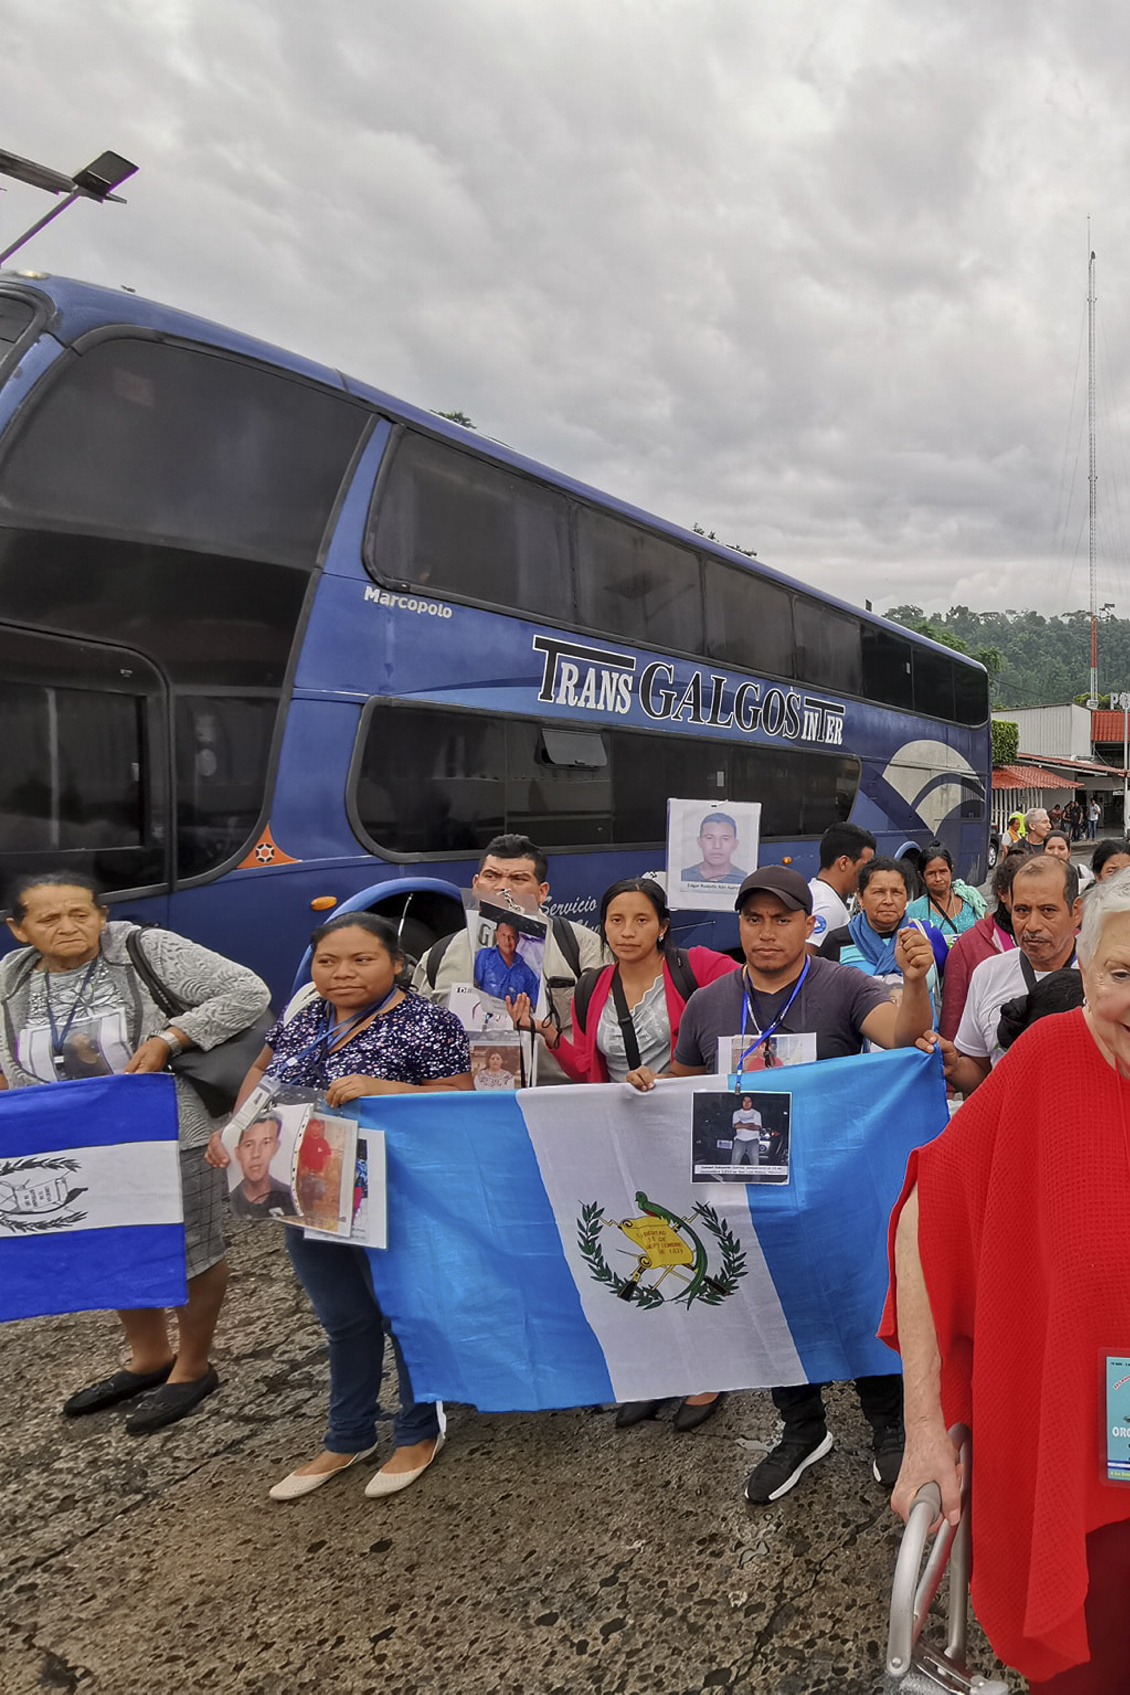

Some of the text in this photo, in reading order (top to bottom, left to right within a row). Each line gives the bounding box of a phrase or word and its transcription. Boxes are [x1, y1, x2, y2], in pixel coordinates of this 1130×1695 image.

[363, 586, 453, 619] Marcopolo
[532, 634, 846, 746] TRANS GALGOS INTER
